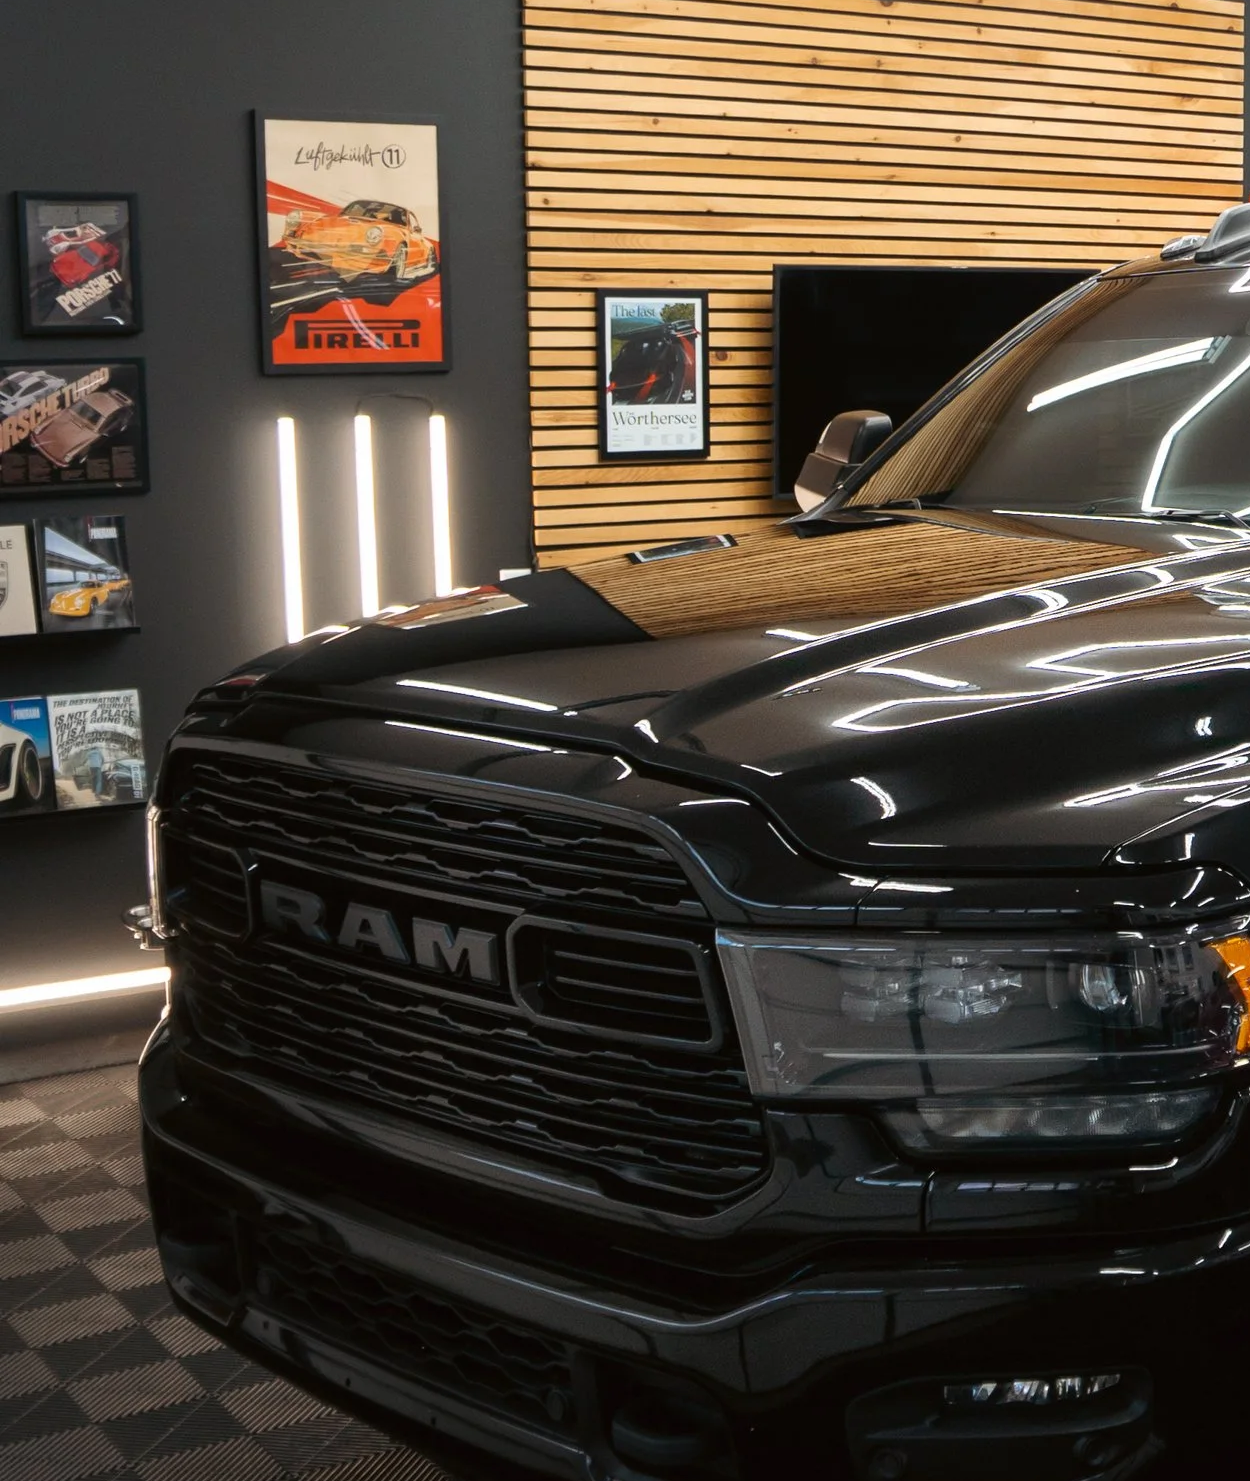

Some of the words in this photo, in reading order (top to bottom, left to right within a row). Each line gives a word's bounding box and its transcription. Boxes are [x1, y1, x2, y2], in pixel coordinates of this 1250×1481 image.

[294, 141, 381, 170] Luftgekühlt
[612, 304, 636, 317] The
[637, 304, 656, 317] last
[293, 319, 421, 350] PIRELLI
[260, 879, 500, 985] RAM
